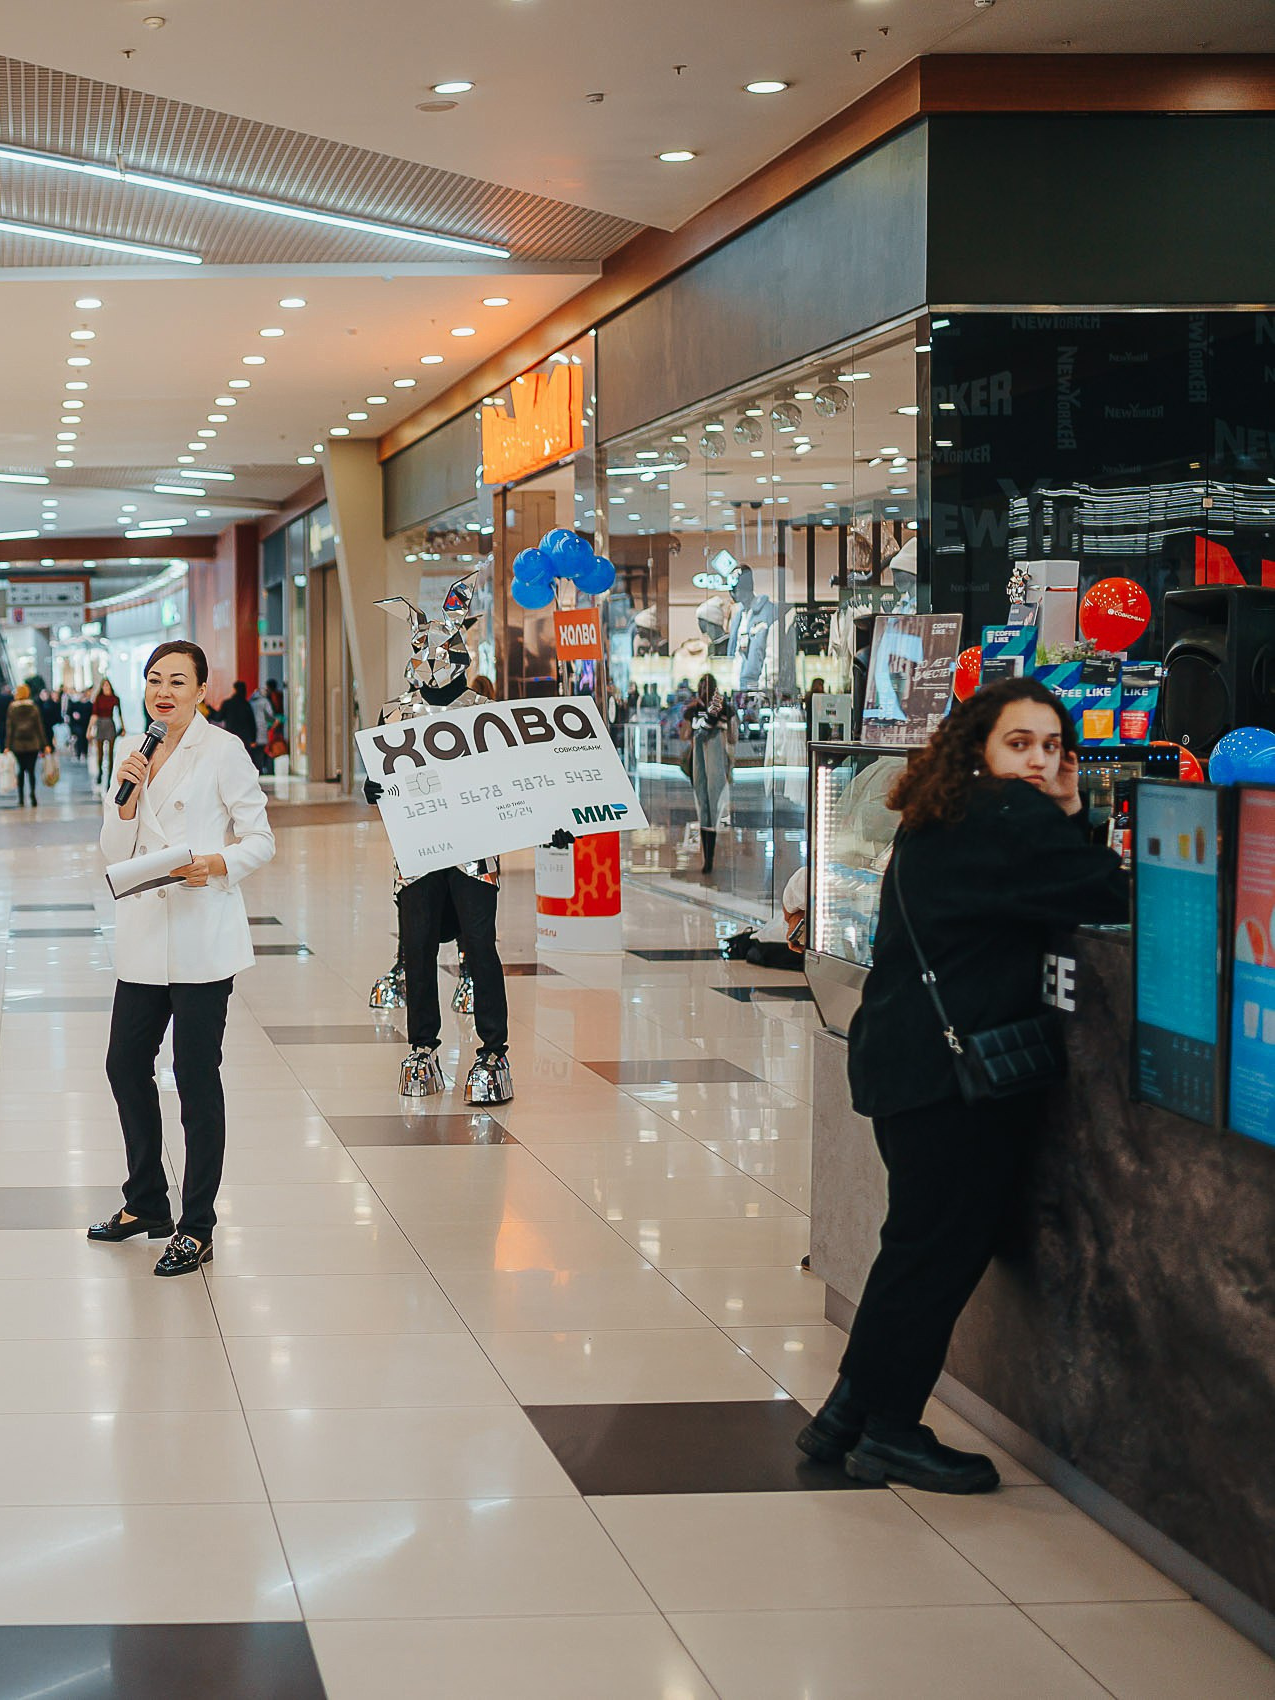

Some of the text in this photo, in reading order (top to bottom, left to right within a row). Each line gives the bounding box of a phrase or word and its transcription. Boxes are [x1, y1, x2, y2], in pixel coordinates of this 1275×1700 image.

[1086, 687, 1112, 697] LIKE
[1124, 687, 1149, 696] LIKE
[553, 744, 603, 755] СОВКОМБАНК
[403, 769, 603, 819] 1234 5678 9876 5432
[496, 803, 511, 811] VALID
[499, 807, 533, 821] 05/24
[572, 803, 629, 825] МИР
[418, 842, 454, 857] HALVA
